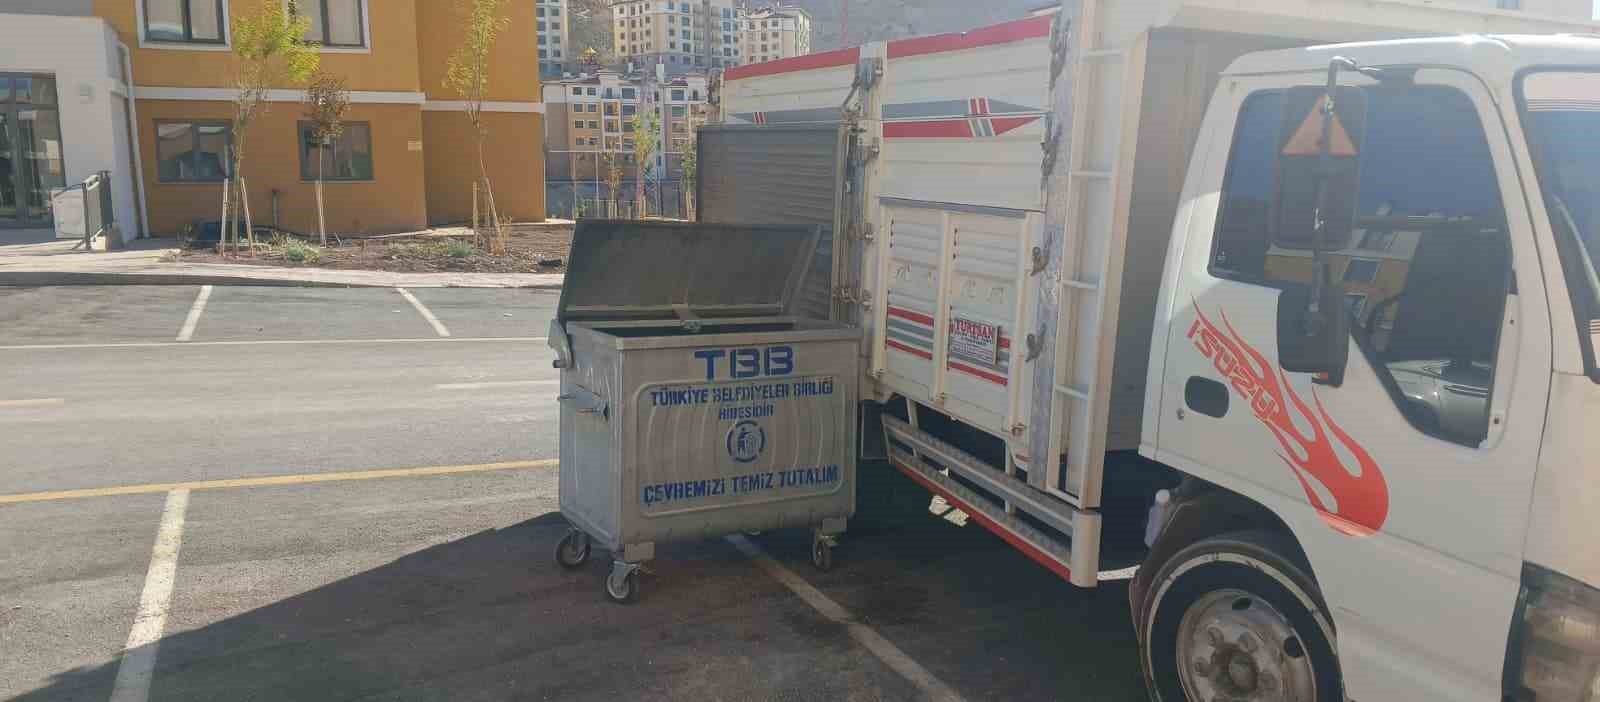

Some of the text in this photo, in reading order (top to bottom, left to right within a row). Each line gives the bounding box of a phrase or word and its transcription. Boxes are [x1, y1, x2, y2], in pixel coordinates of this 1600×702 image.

[694, 346, 794, 381] TBB
[1187, 319, 1277, 420] ISUZU
[651, 385, 710, 407] TÜRKİYE
[794, 376, 834, 397] BİRLİĞİ
[732, 471, 774, 494] TEMİZ
[779, 464, 840, 488] TUTALIM
